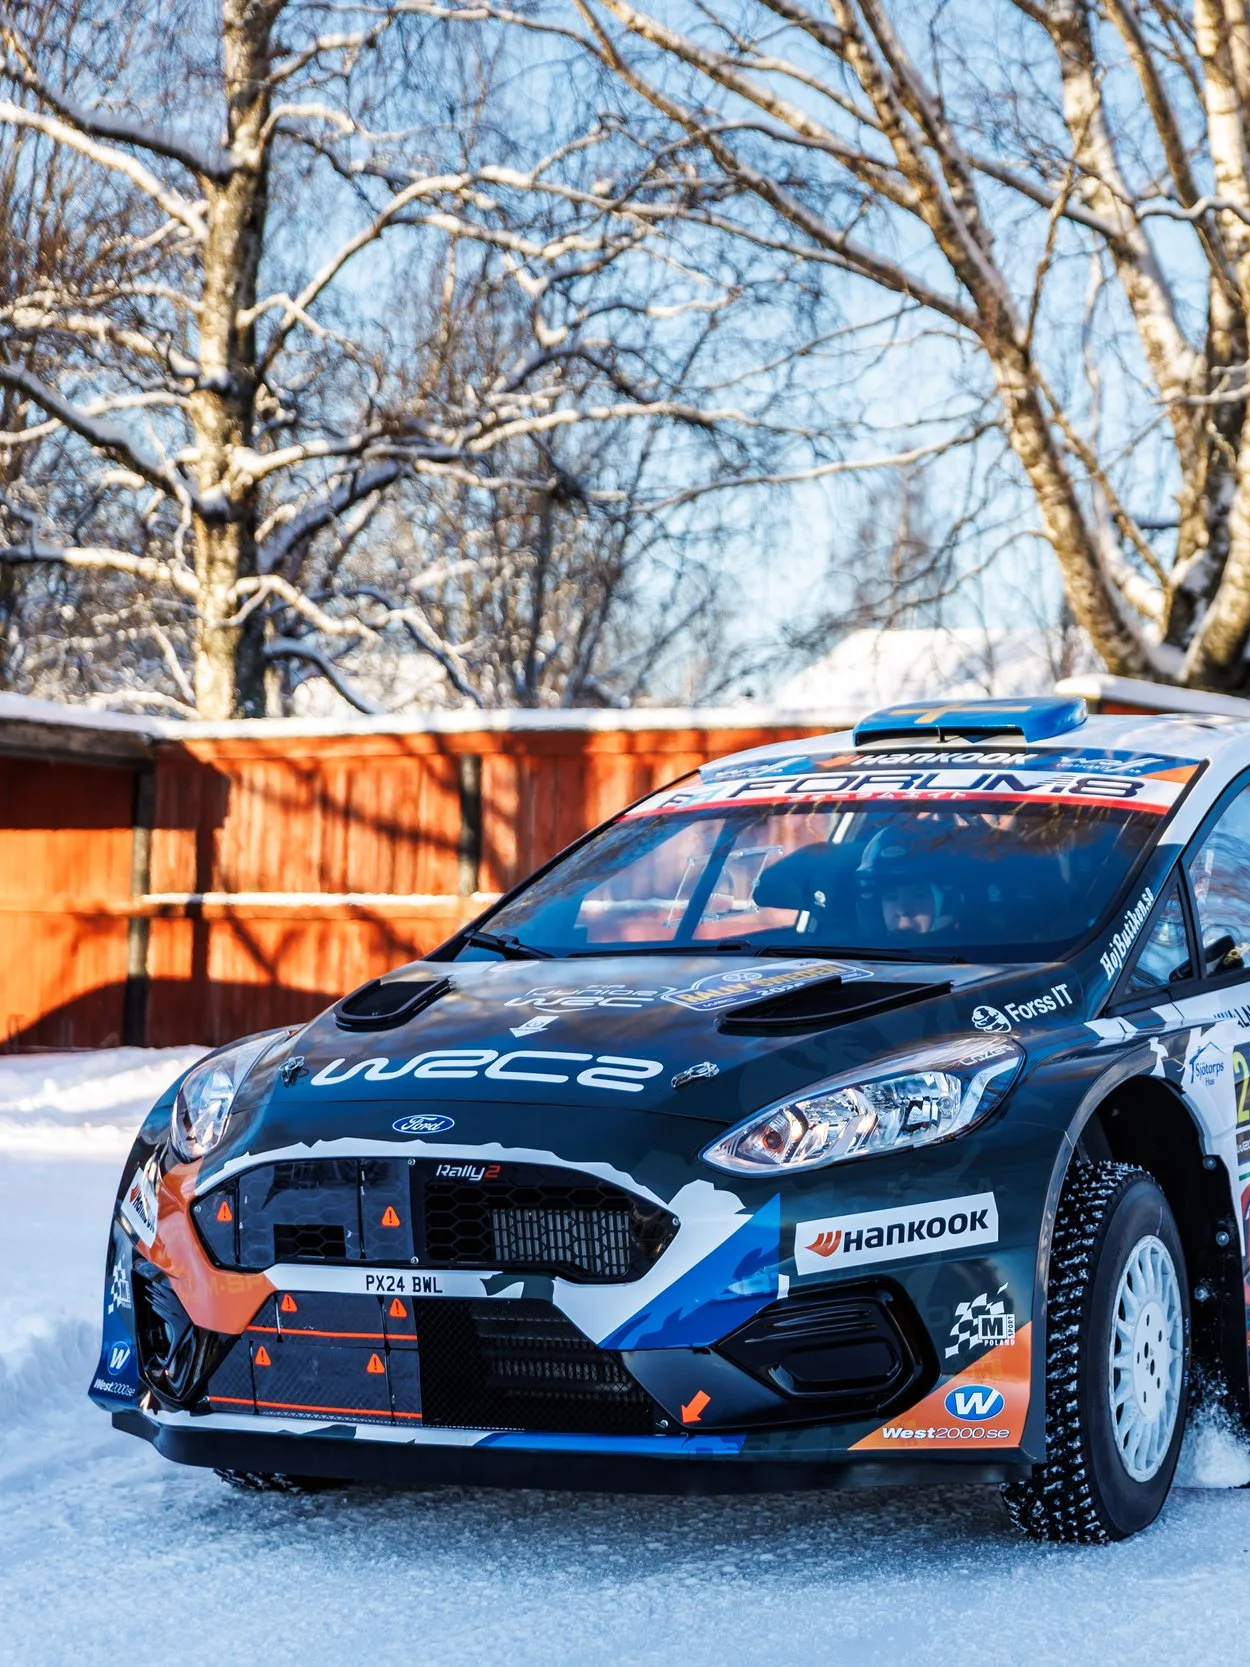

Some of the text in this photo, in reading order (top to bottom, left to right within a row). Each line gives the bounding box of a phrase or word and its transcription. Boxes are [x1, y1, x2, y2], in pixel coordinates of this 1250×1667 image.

[729, 772, 1145, 798] FORUM8
[1004, 983, 1073, 1022] Forss IT
[401, 1116, 443, 1131] Ford
[436, 1164, 501, 1181] Rally2
[366, 1275, 443, 1293] PX24 BWL
[955, 1388, 1000, 1415] W
[882, 1427, 1010, 1440] West2000.se
